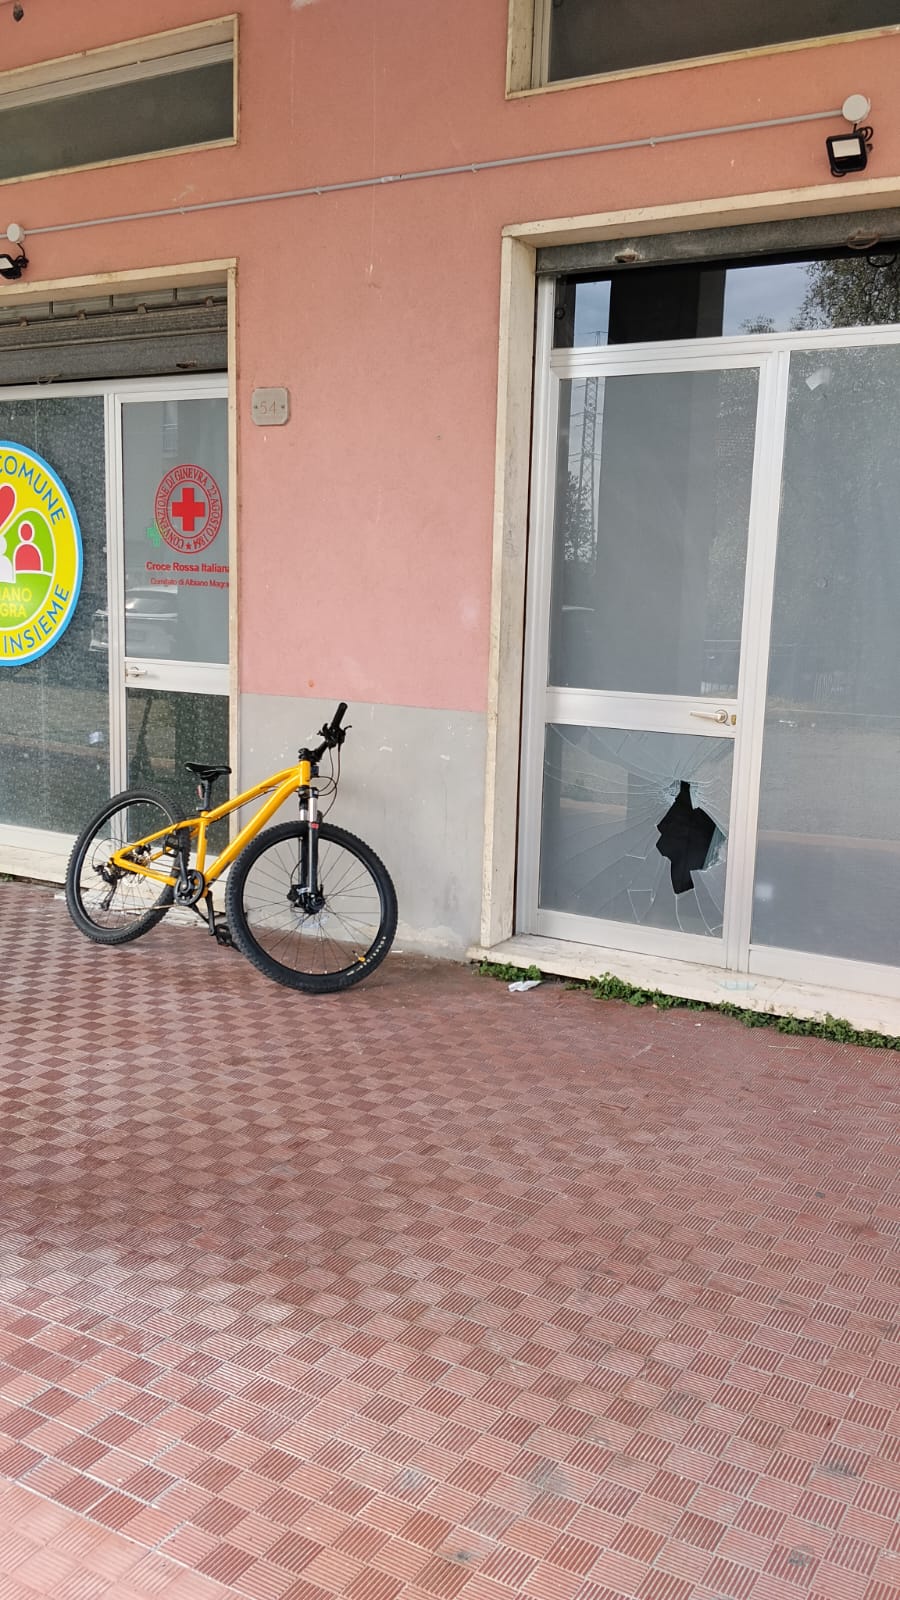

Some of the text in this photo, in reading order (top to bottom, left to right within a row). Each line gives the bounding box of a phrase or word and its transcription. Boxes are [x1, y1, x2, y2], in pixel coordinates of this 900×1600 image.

[260, 400, 277, 416] 54
[166, 477, 176, 489] DI
[174, 467, 208, 487] GINEVRA
[0, 455, 66, 525] OMUNE
[157, 487, 184, 550] CONVENZIONE
[146, 561, 171, 571] Croce
[173, 562, 199, 572] Rossa
[4, 584, 69, 654] INSIEME
